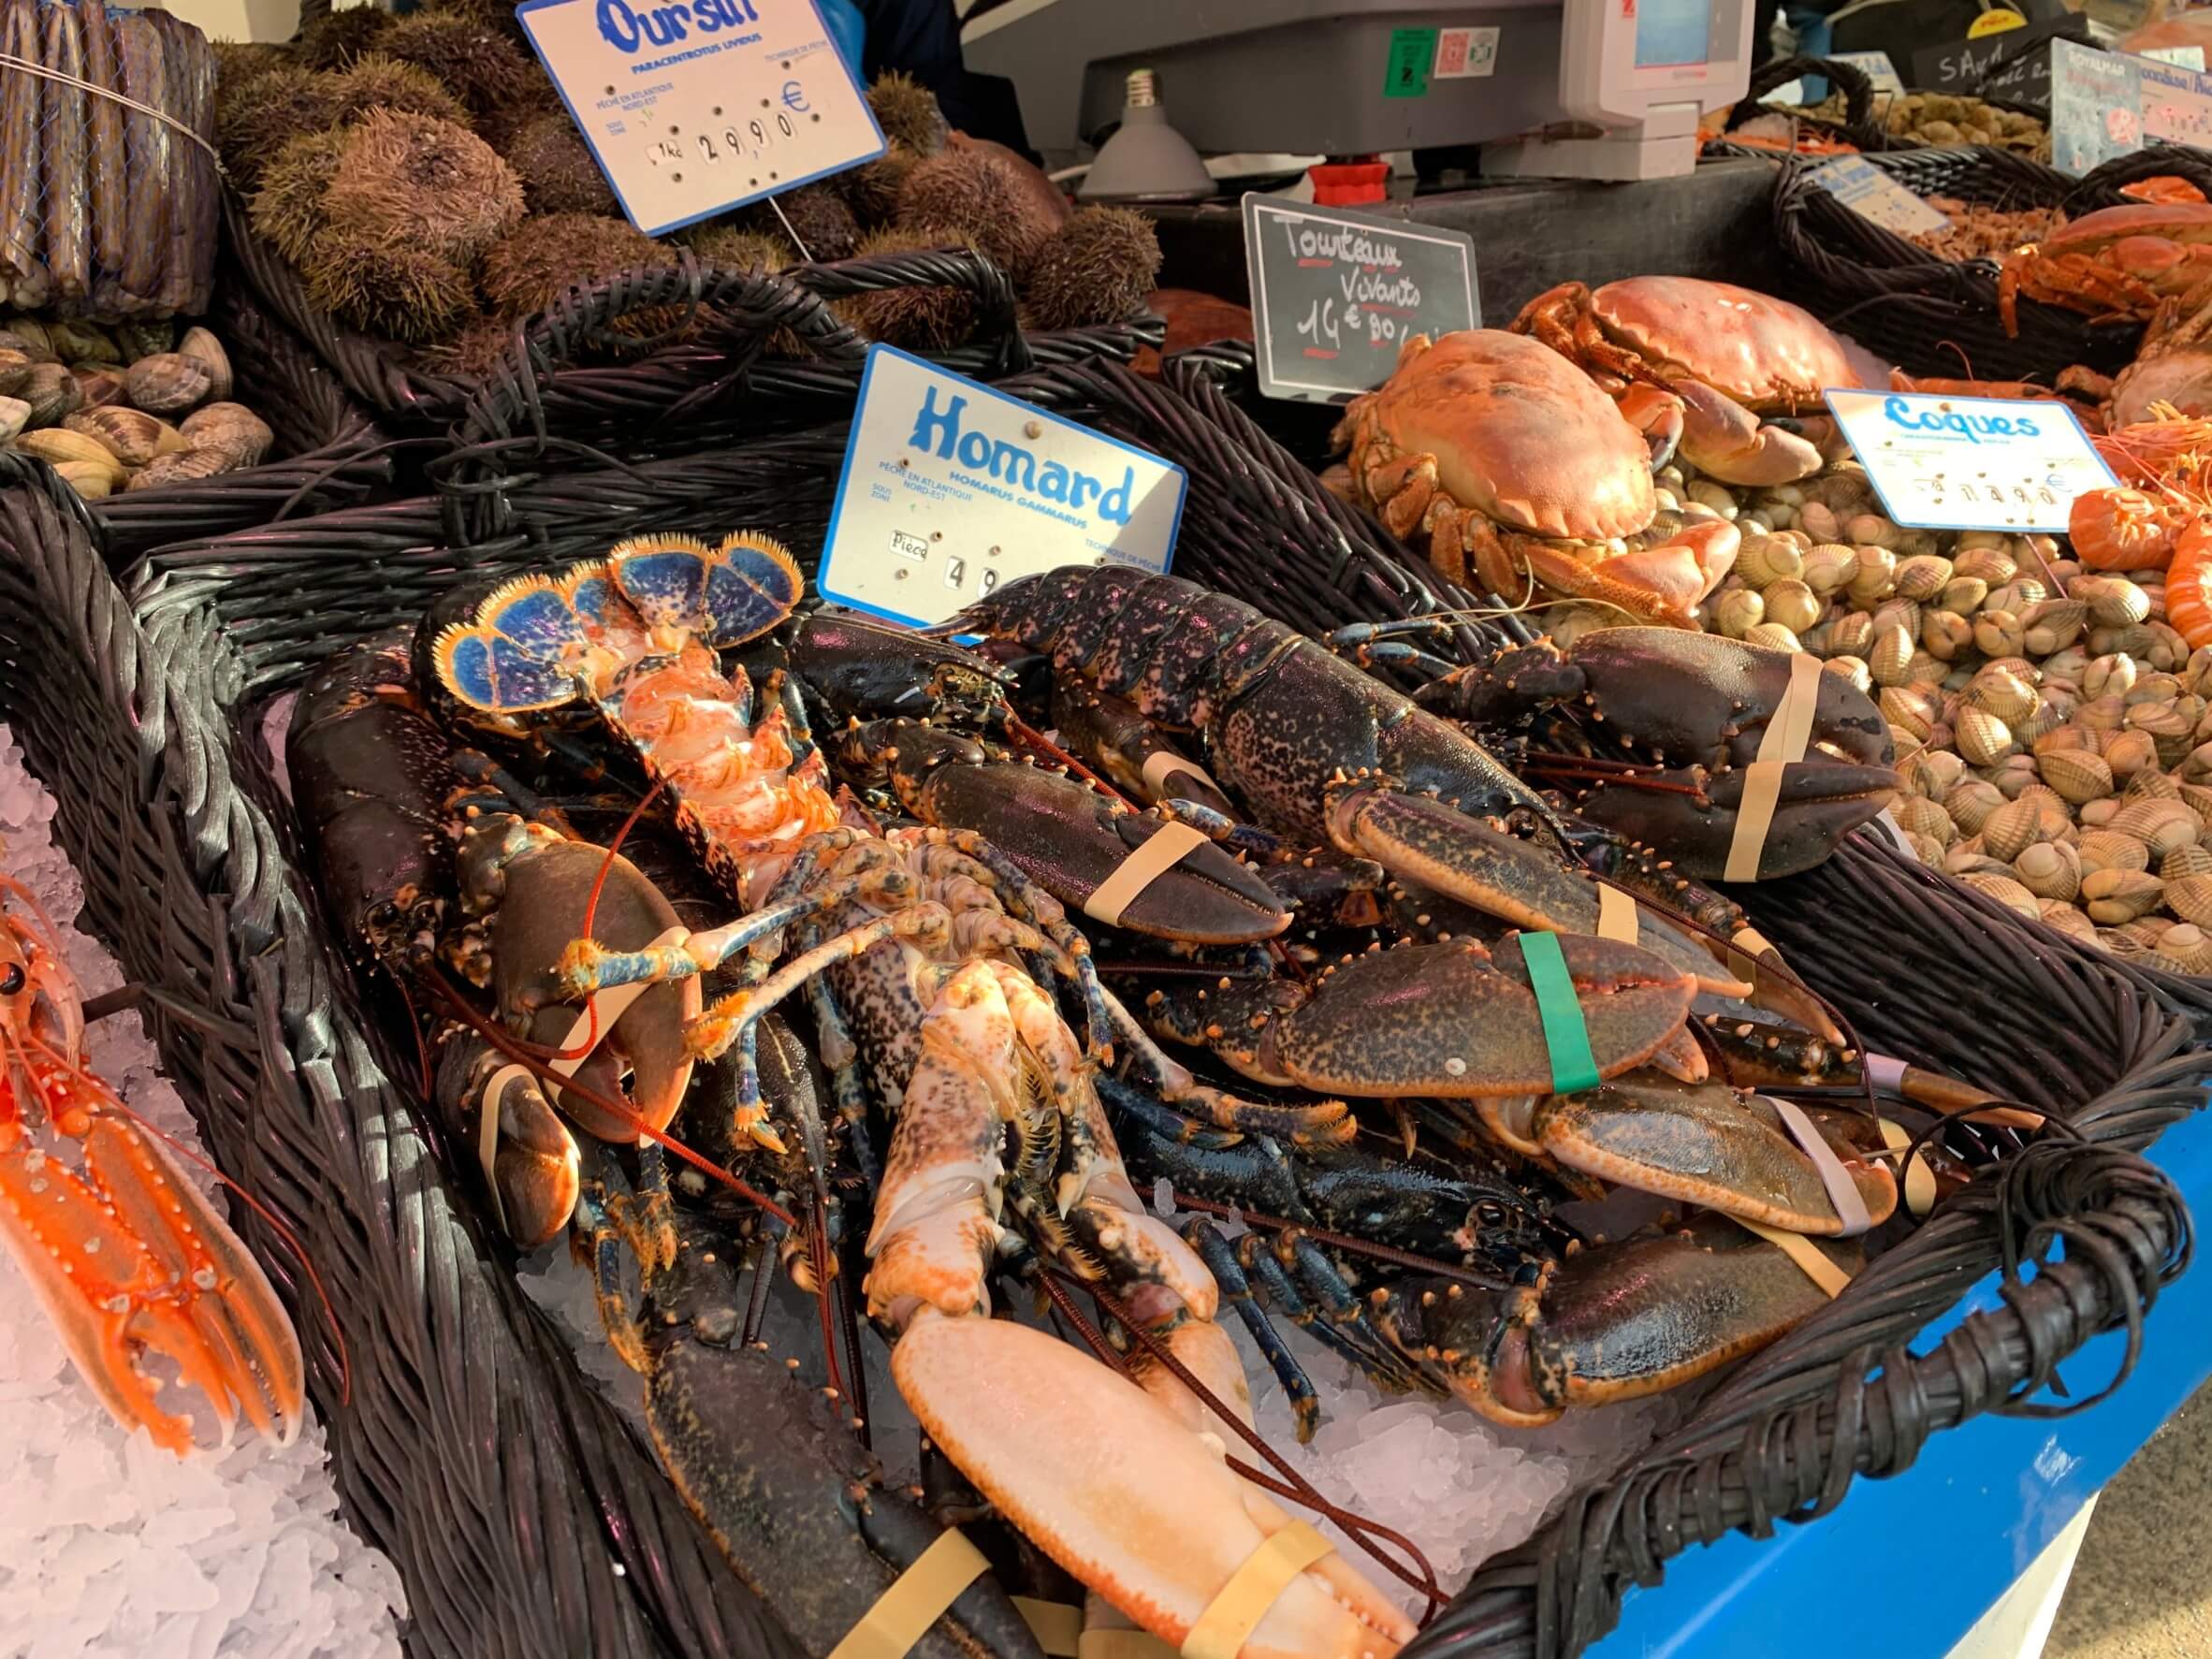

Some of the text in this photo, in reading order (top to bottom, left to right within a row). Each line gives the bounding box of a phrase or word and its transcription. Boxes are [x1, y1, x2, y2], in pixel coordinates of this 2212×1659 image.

[631, 44, 722, 75] PARACENTROTUS
[1884, 396, 2041, 444] Coques
[909, 385, 1133, 526] Homard
[908, 473, 920, 483] EN
[949, 471, 1088, 529] HOMARUS GAMMARUS
[892, 531, 927, 560] Pièce
